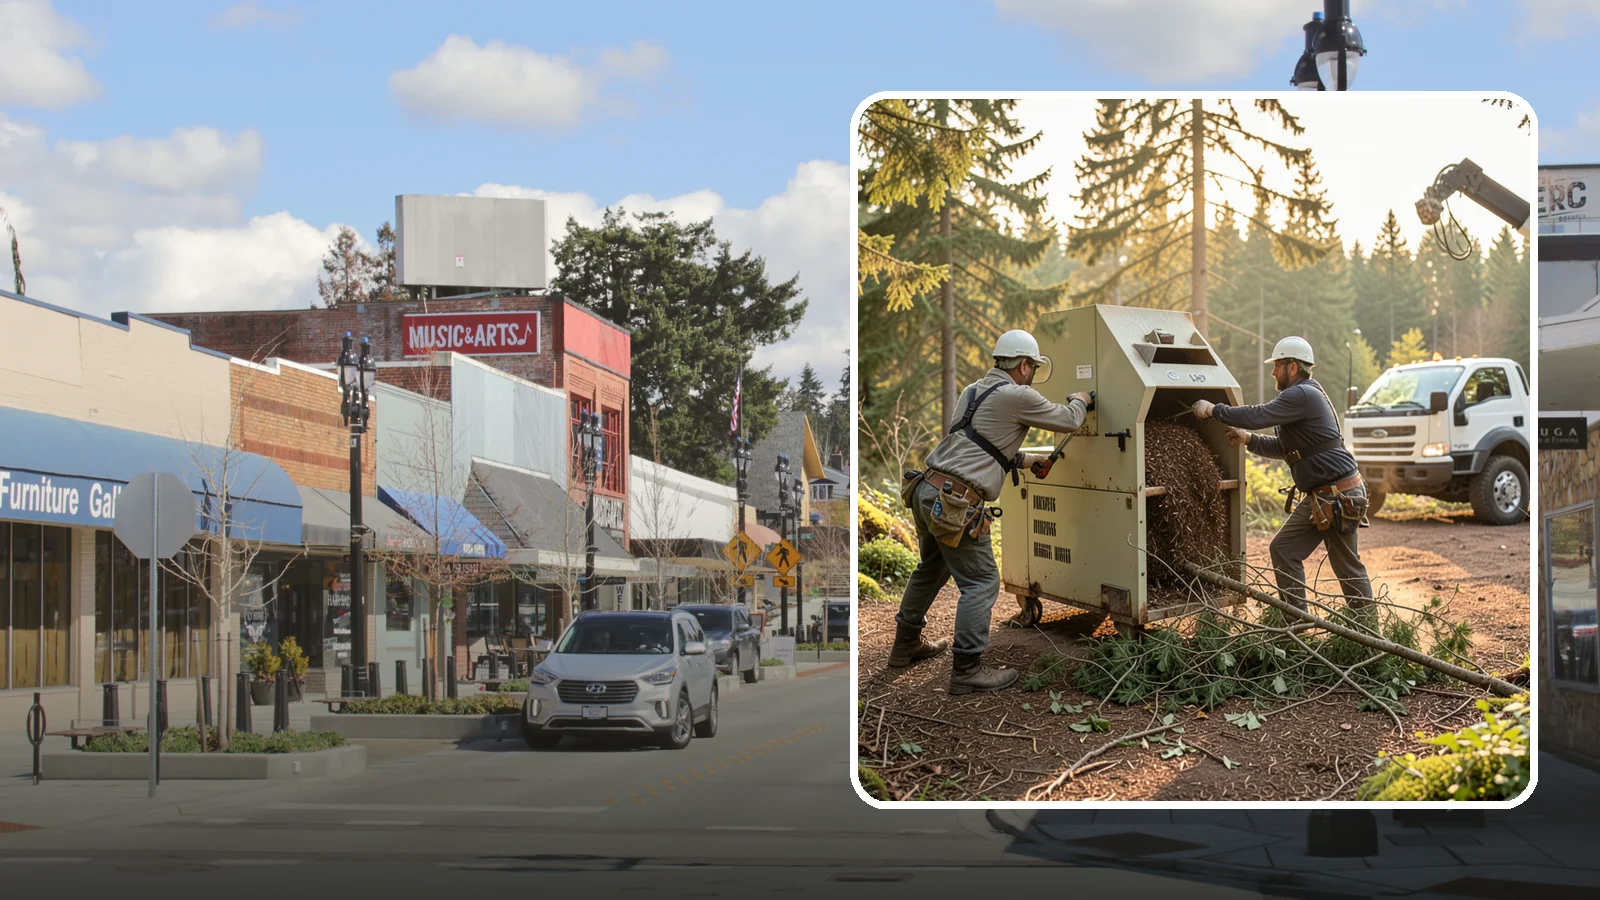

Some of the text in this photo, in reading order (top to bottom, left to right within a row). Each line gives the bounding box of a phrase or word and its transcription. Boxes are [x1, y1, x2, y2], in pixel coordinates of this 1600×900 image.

[409, 323, 519, 349] MUSIC&ARTS
[1540, 427, 1577, 436] UGA
[0, 472, 122, 519] Furniture Gal
